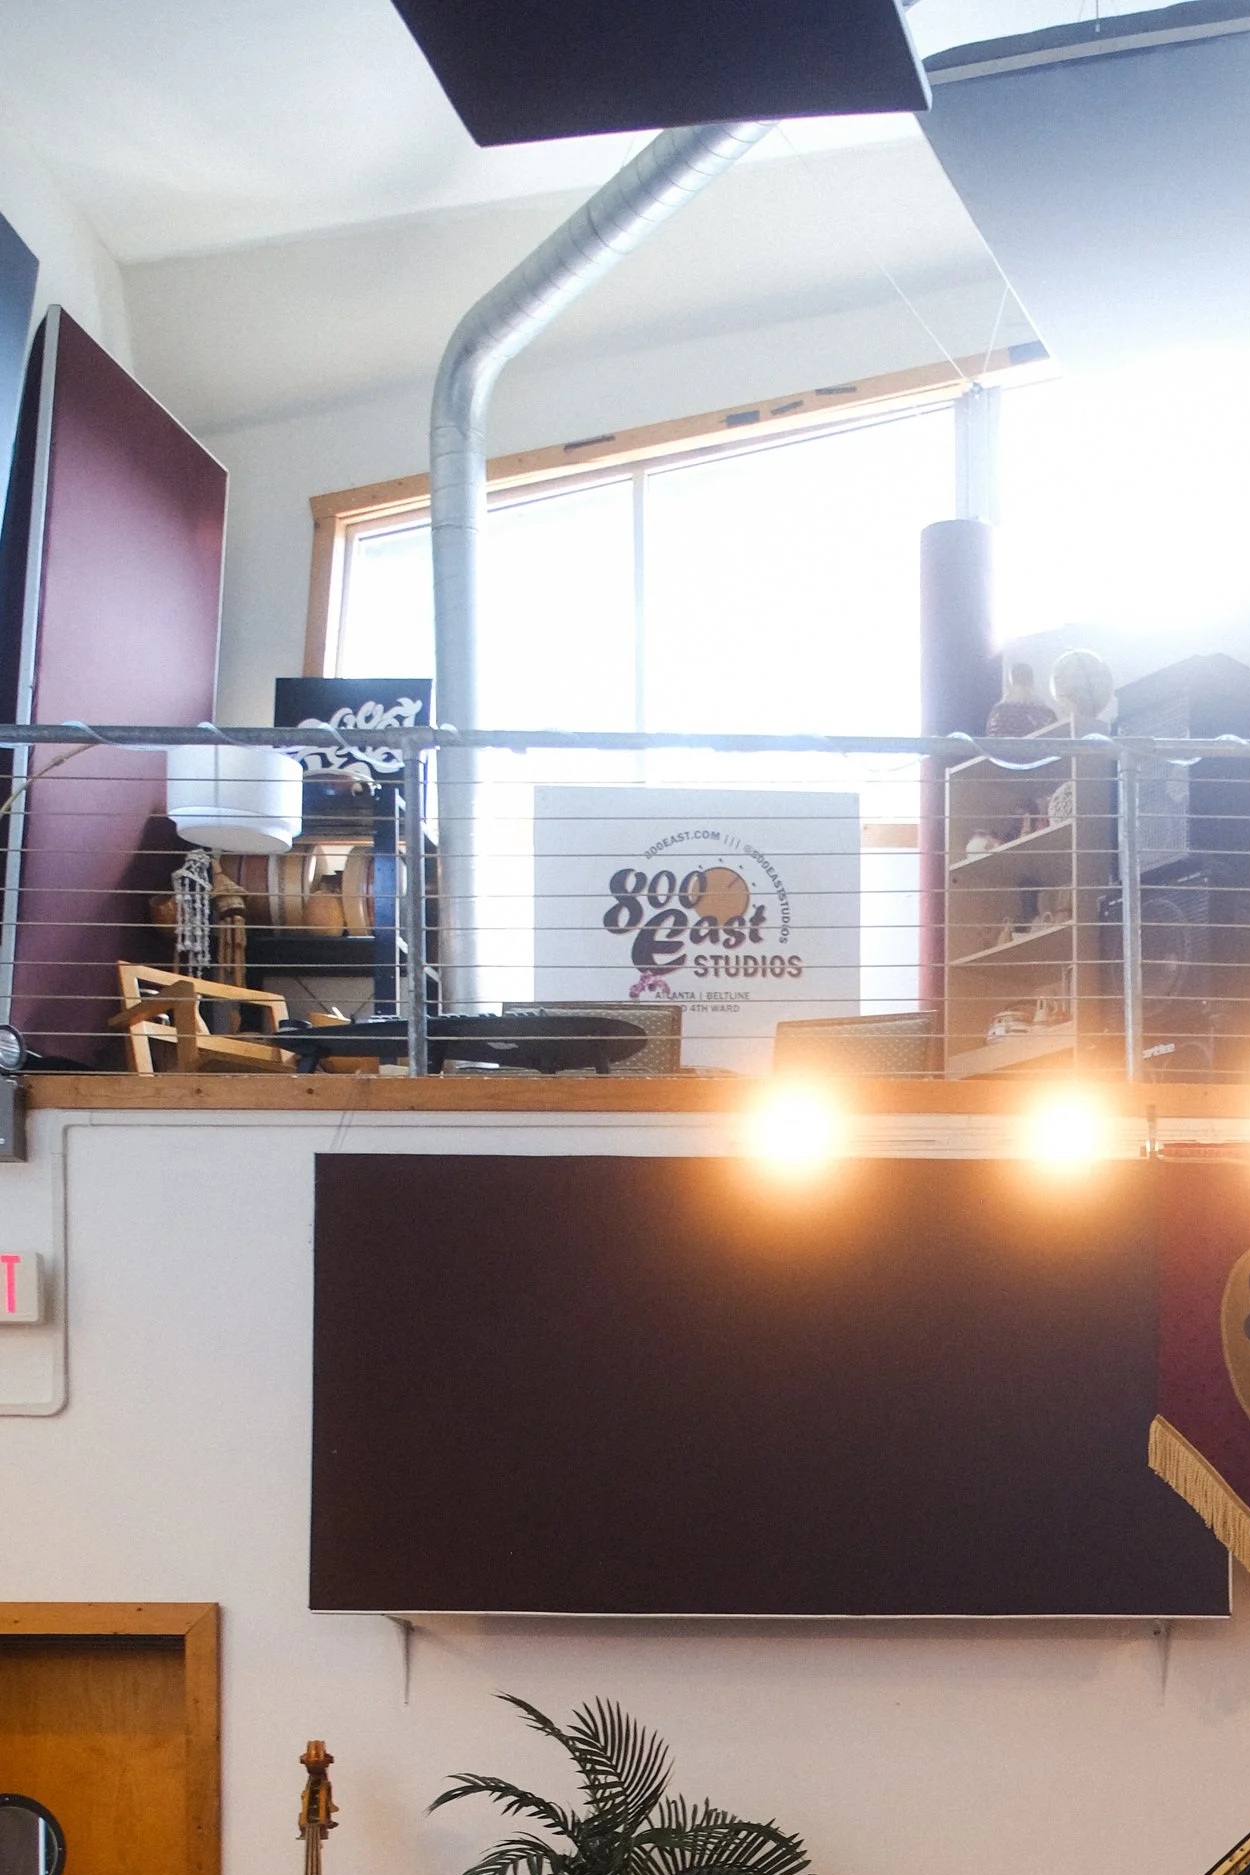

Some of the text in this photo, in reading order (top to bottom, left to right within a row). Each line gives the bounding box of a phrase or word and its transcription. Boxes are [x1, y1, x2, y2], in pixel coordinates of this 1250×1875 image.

[603, 868, 708, 935] 800
[632, 904, 767, 976] East
[693, 954, 804, 979] STUDIOS
[706, 991, 751, 1000] BELTLINE
[690, 1004, 709, 1013] 4TH
[711, 1004, 741, 1013] WARD
